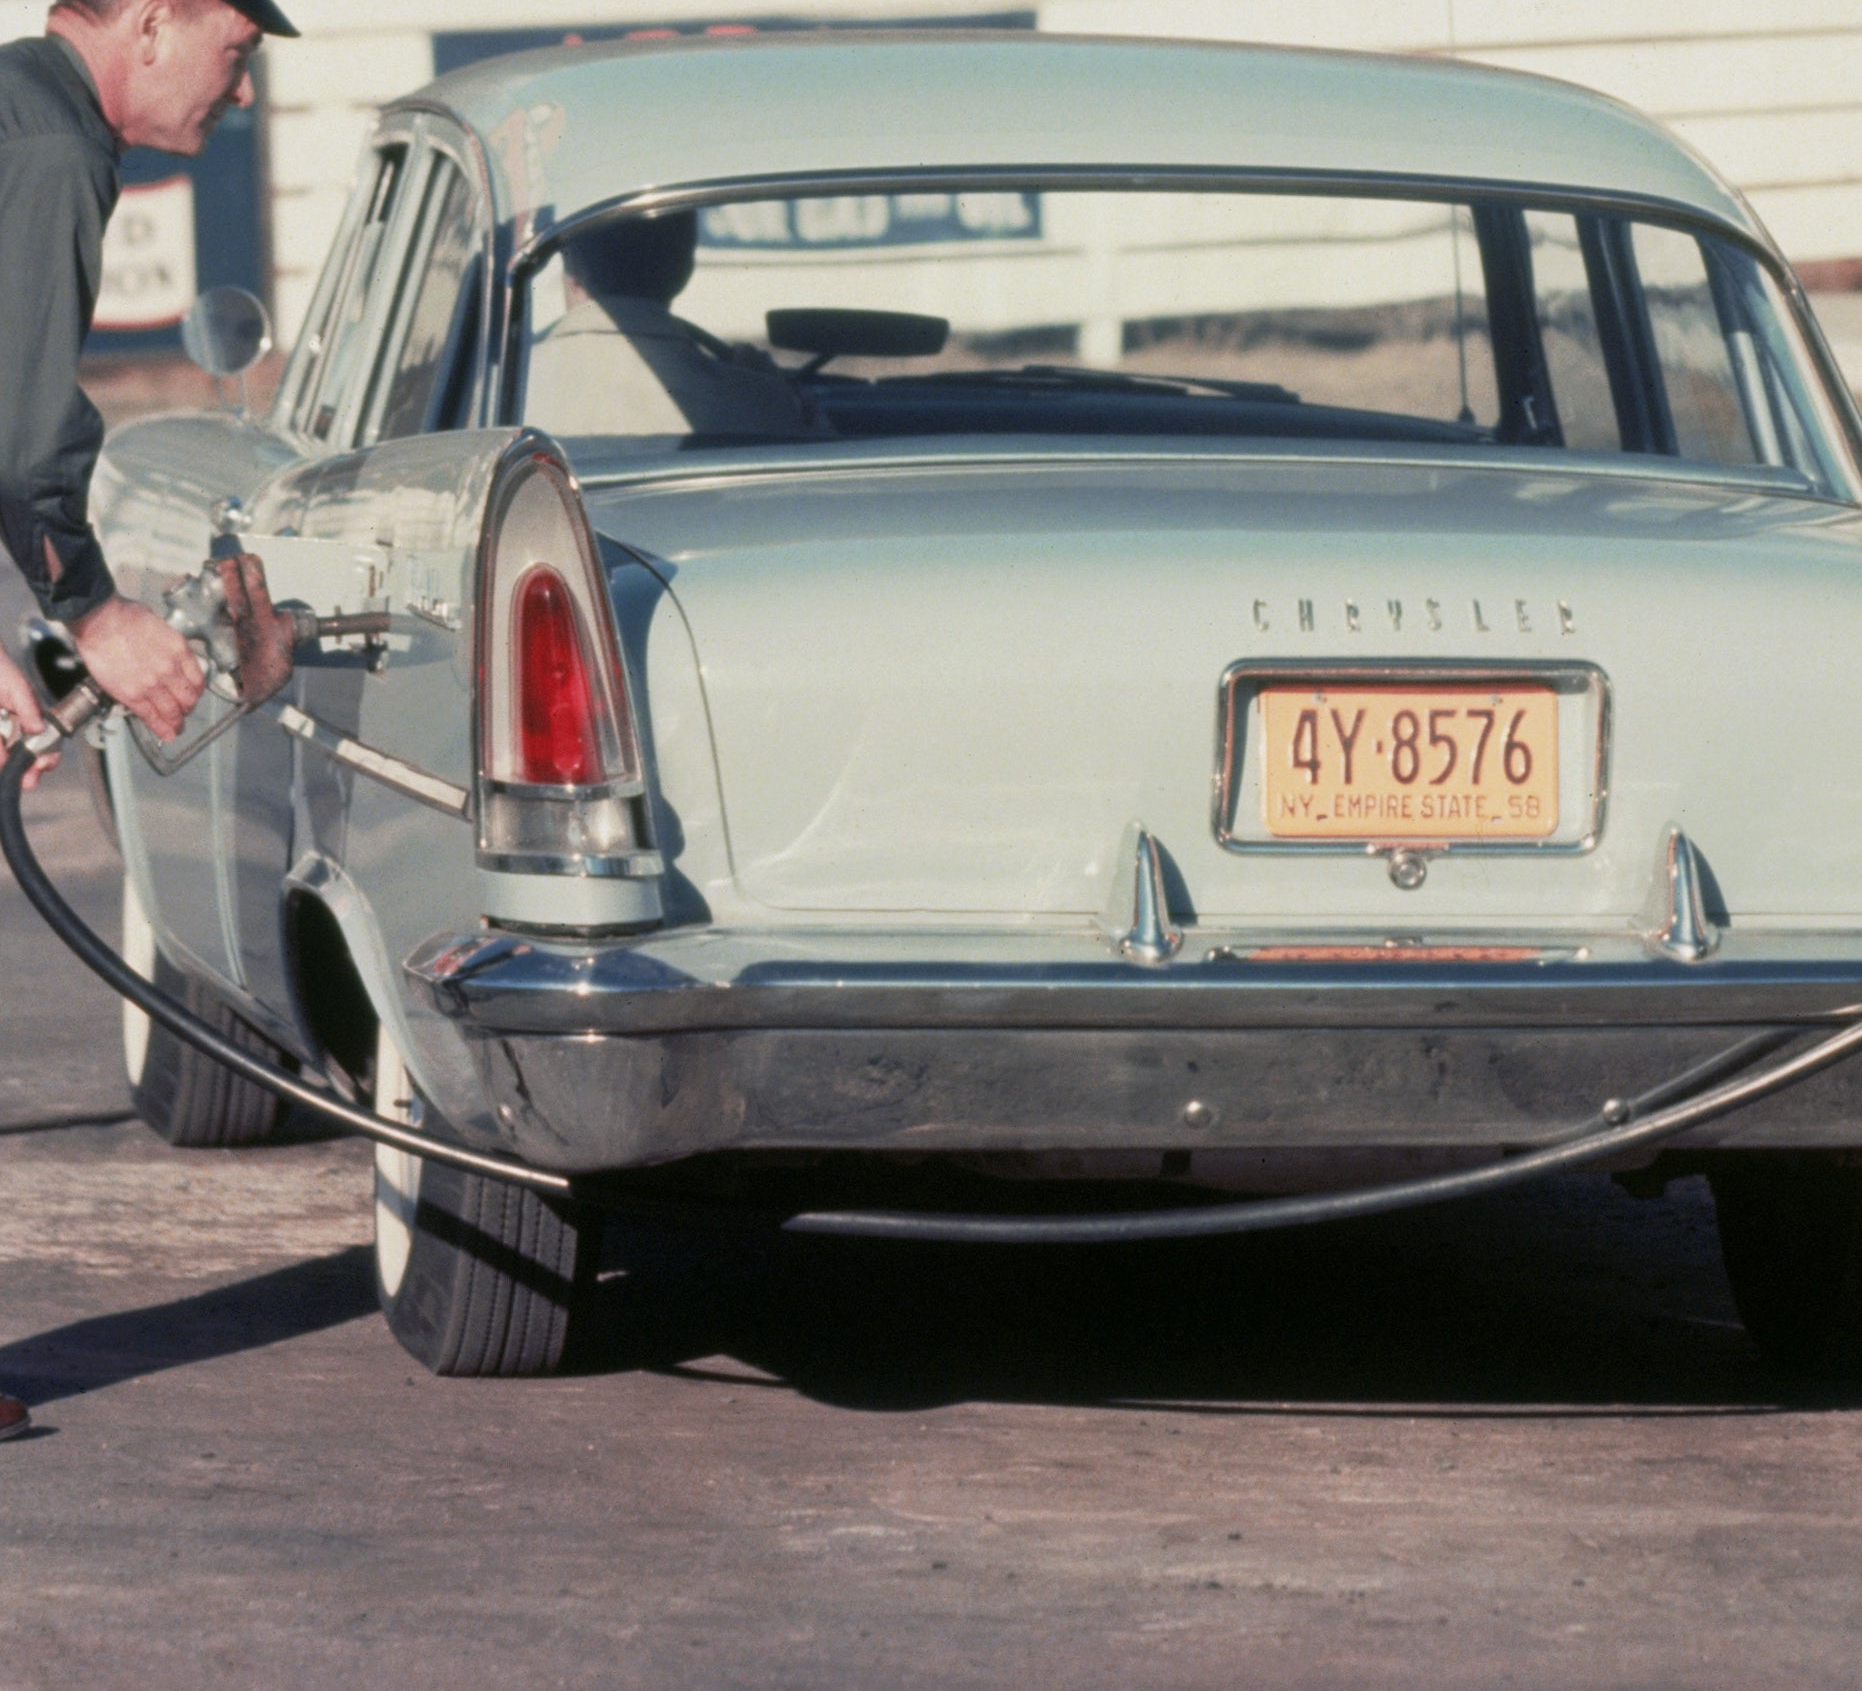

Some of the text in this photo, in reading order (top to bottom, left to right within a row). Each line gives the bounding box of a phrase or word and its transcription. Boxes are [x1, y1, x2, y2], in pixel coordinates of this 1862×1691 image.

[1252, 597, 1576, 633] CHRYSLER
[1281, 794, 1542, 820] NY EMPIRE STATE 58
